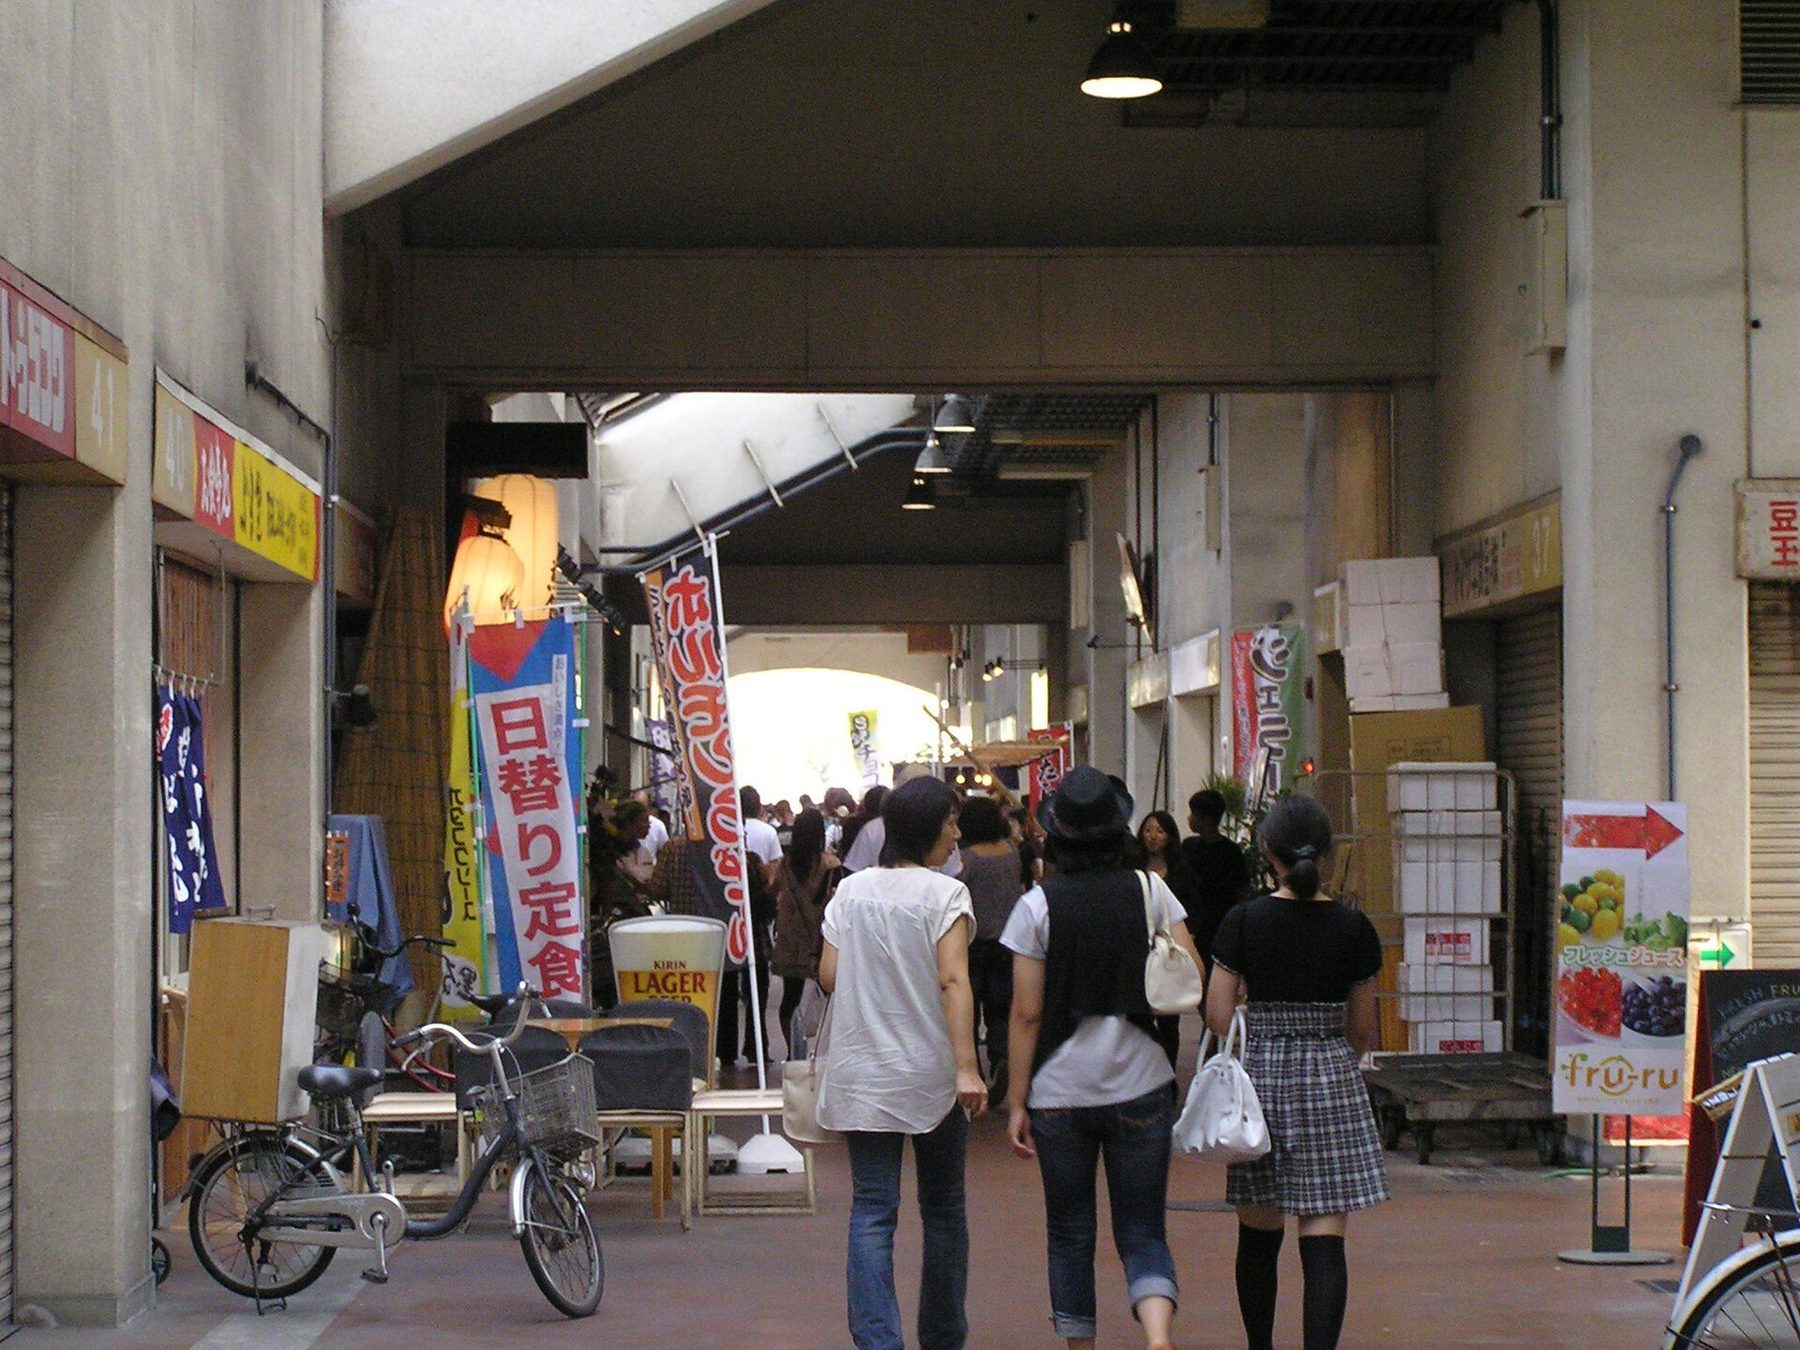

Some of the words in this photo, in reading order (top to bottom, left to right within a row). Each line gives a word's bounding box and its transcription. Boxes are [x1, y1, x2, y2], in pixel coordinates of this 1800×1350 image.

[91, 358, 114, 451] 41
[490, 696, 581, 1000] 日替り定食
[653, 960, 687, 970] KIRIN
[1563, 945, 1686, 968] フレッシュジュース
[633, 972, 707, 994] LAGER
